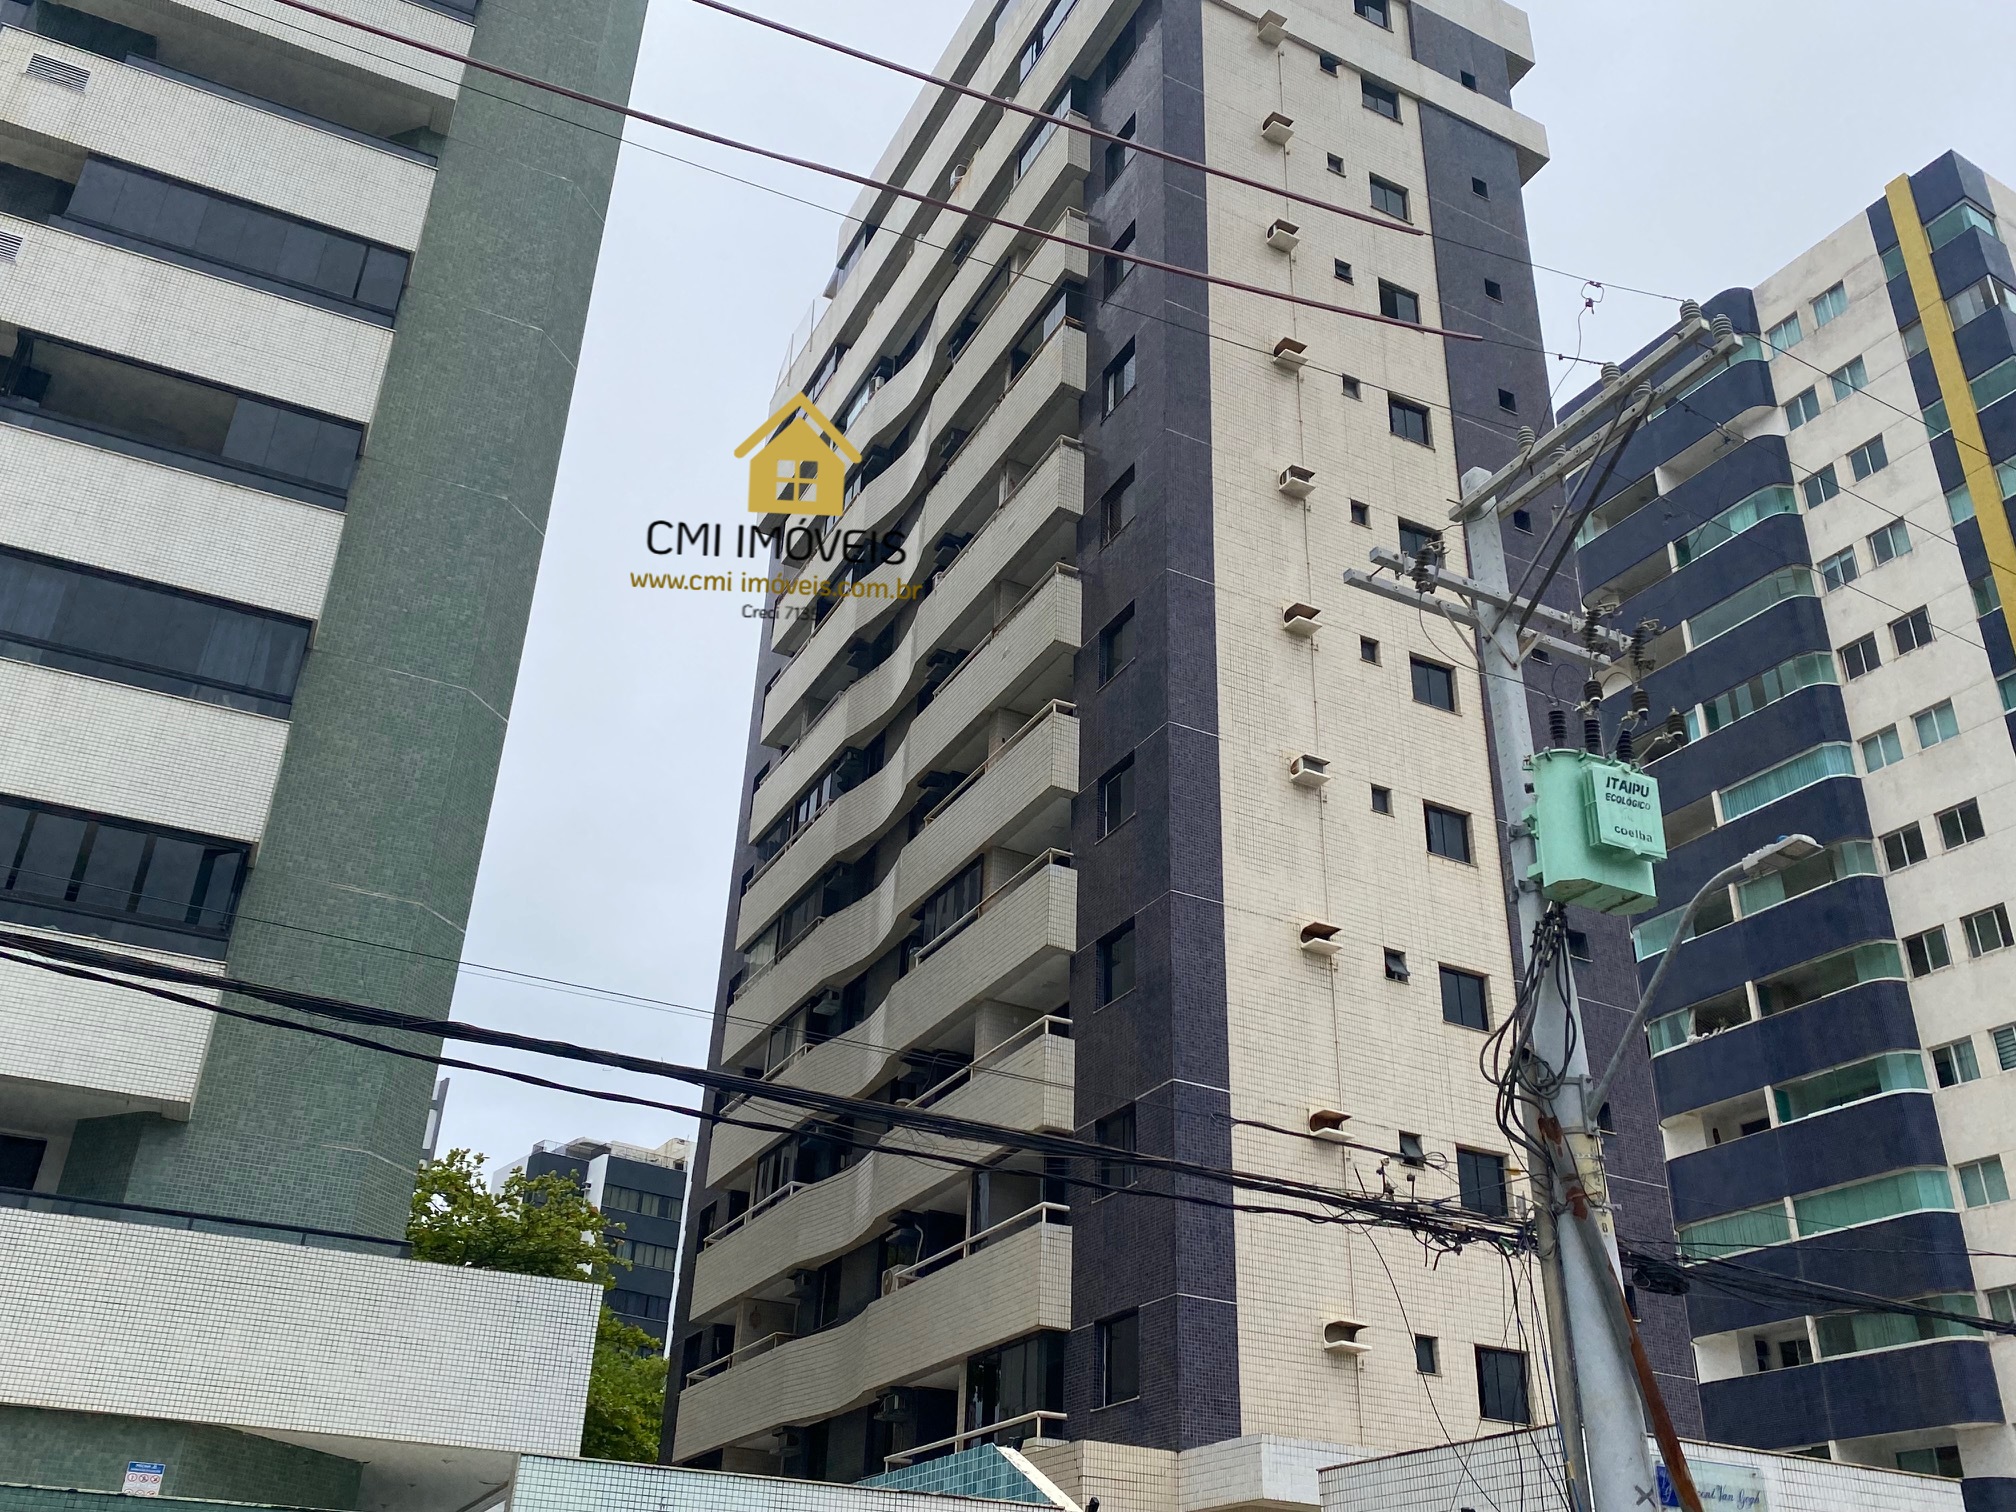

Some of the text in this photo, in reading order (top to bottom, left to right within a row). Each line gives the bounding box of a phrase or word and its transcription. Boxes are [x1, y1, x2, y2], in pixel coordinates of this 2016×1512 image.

[1606, 776, 1650, 798] ITAIPU
[1605, 792, 1651, 811] ECOLÓGICO
[1614, 825, 1653, 843] coelba
